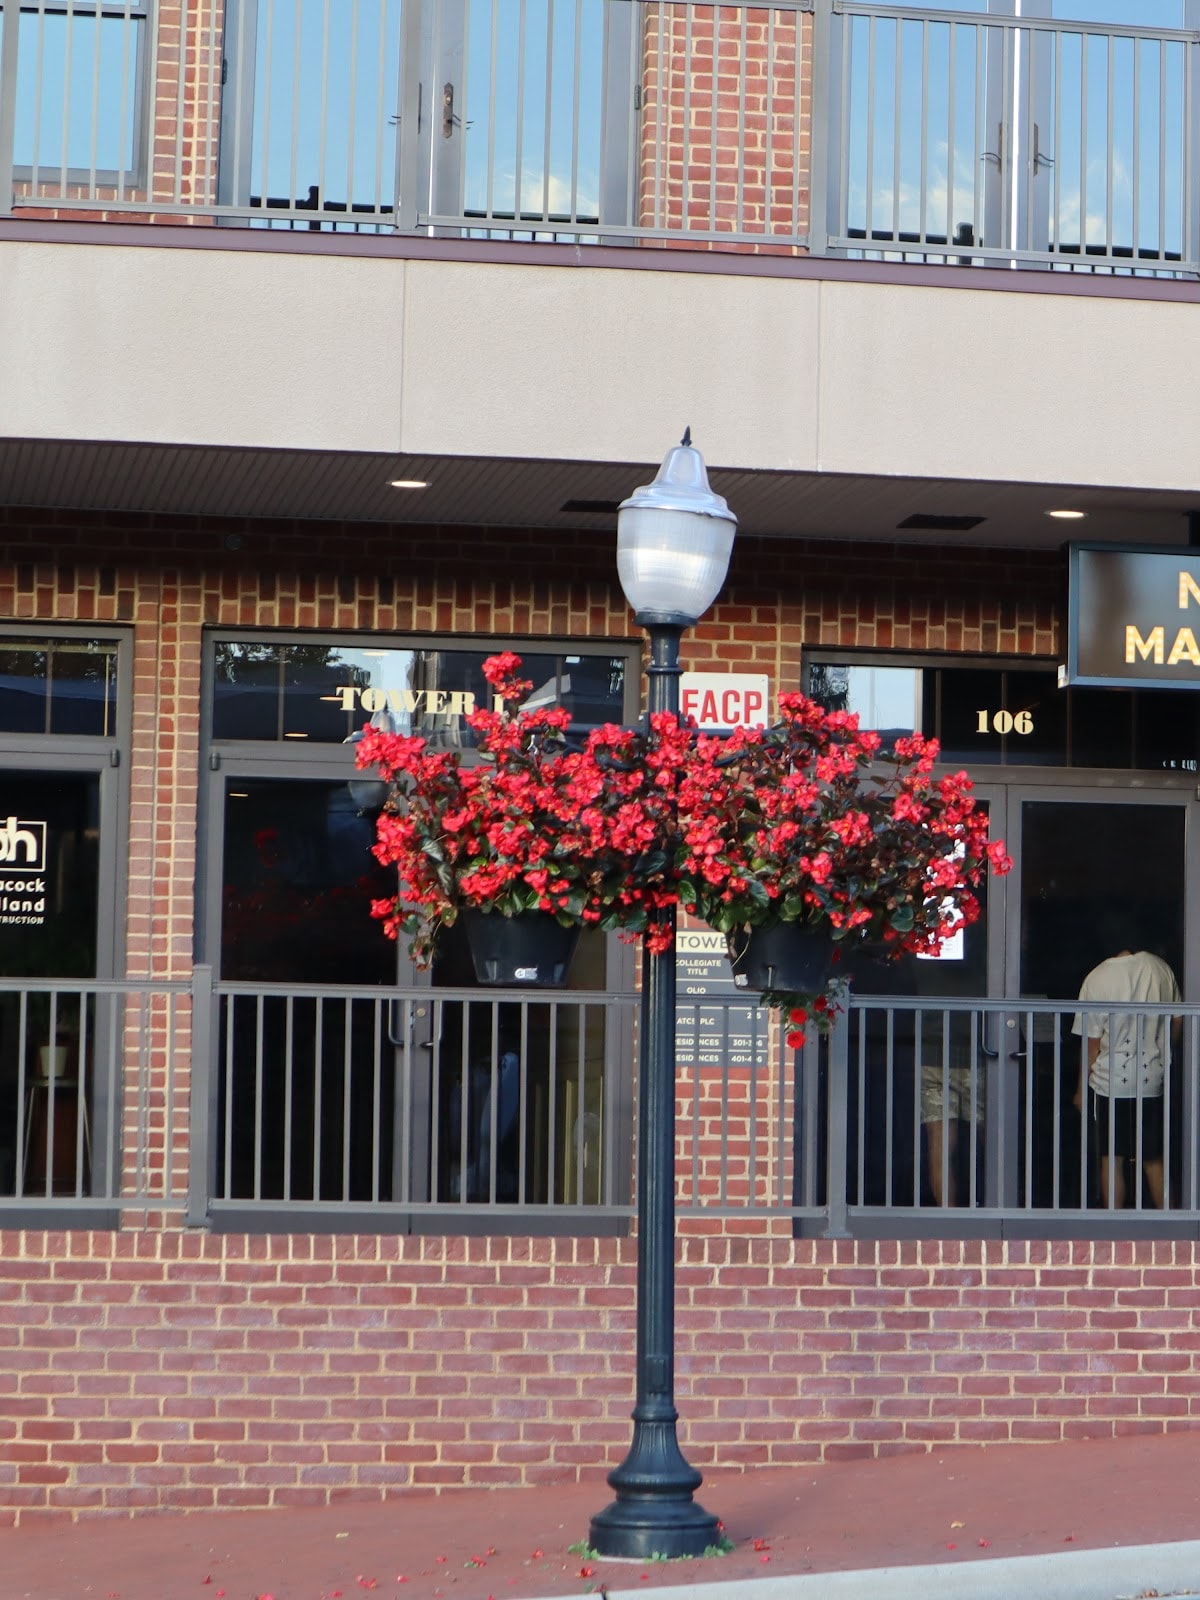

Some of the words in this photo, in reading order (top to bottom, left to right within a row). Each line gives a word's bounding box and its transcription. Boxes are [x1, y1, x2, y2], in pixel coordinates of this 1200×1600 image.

[336, 686, 475, 716] TOWER
[682, 689, 762, 724] FACP
[976, 709, 1034, 735] 106
[677, 935, 728, 949] TOWE
[687, 967, 708, 976] TITLE
[686, 986, 706, 994] OLIO
[746, 1011, 762, 1019] 25
[700, 1017, 715, 1025] PLC
[675, 1038, 720, 1046] ESIDNCES
[675, 1054, 720, 1062] ESIDNCES
[731, 1055, 763, 1063] 401-46
